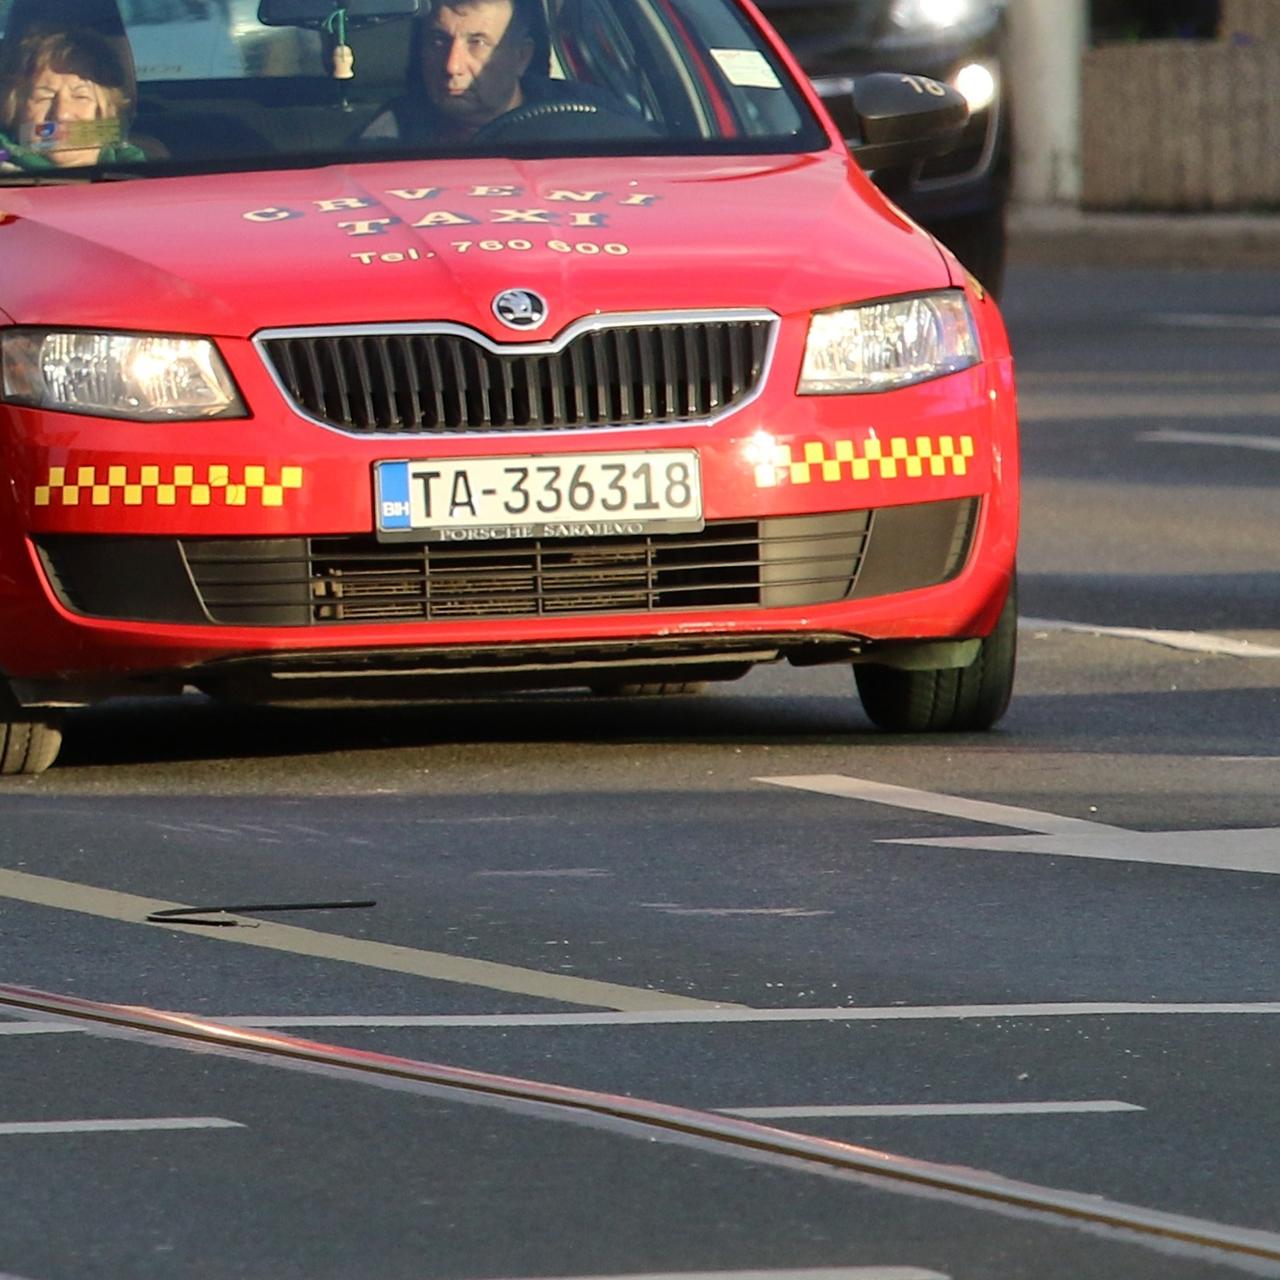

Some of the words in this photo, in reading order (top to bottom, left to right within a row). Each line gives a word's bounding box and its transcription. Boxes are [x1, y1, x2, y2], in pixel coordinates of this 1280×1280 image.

[242, 185, 660, 222] CRVENI
[337, 208, 609, 237] TAXI
[349, 249, 437, 265] Tel.
[450, 239, 533, 254] 760
[546, 239, 630, 257] 600
[411, 462, 692, 519] TA-336318
[382, 502, 409, 517] BIH
[439, 526, 534, 542] PORSCHE
[543, 520, 644, 537] SARAJEVO
